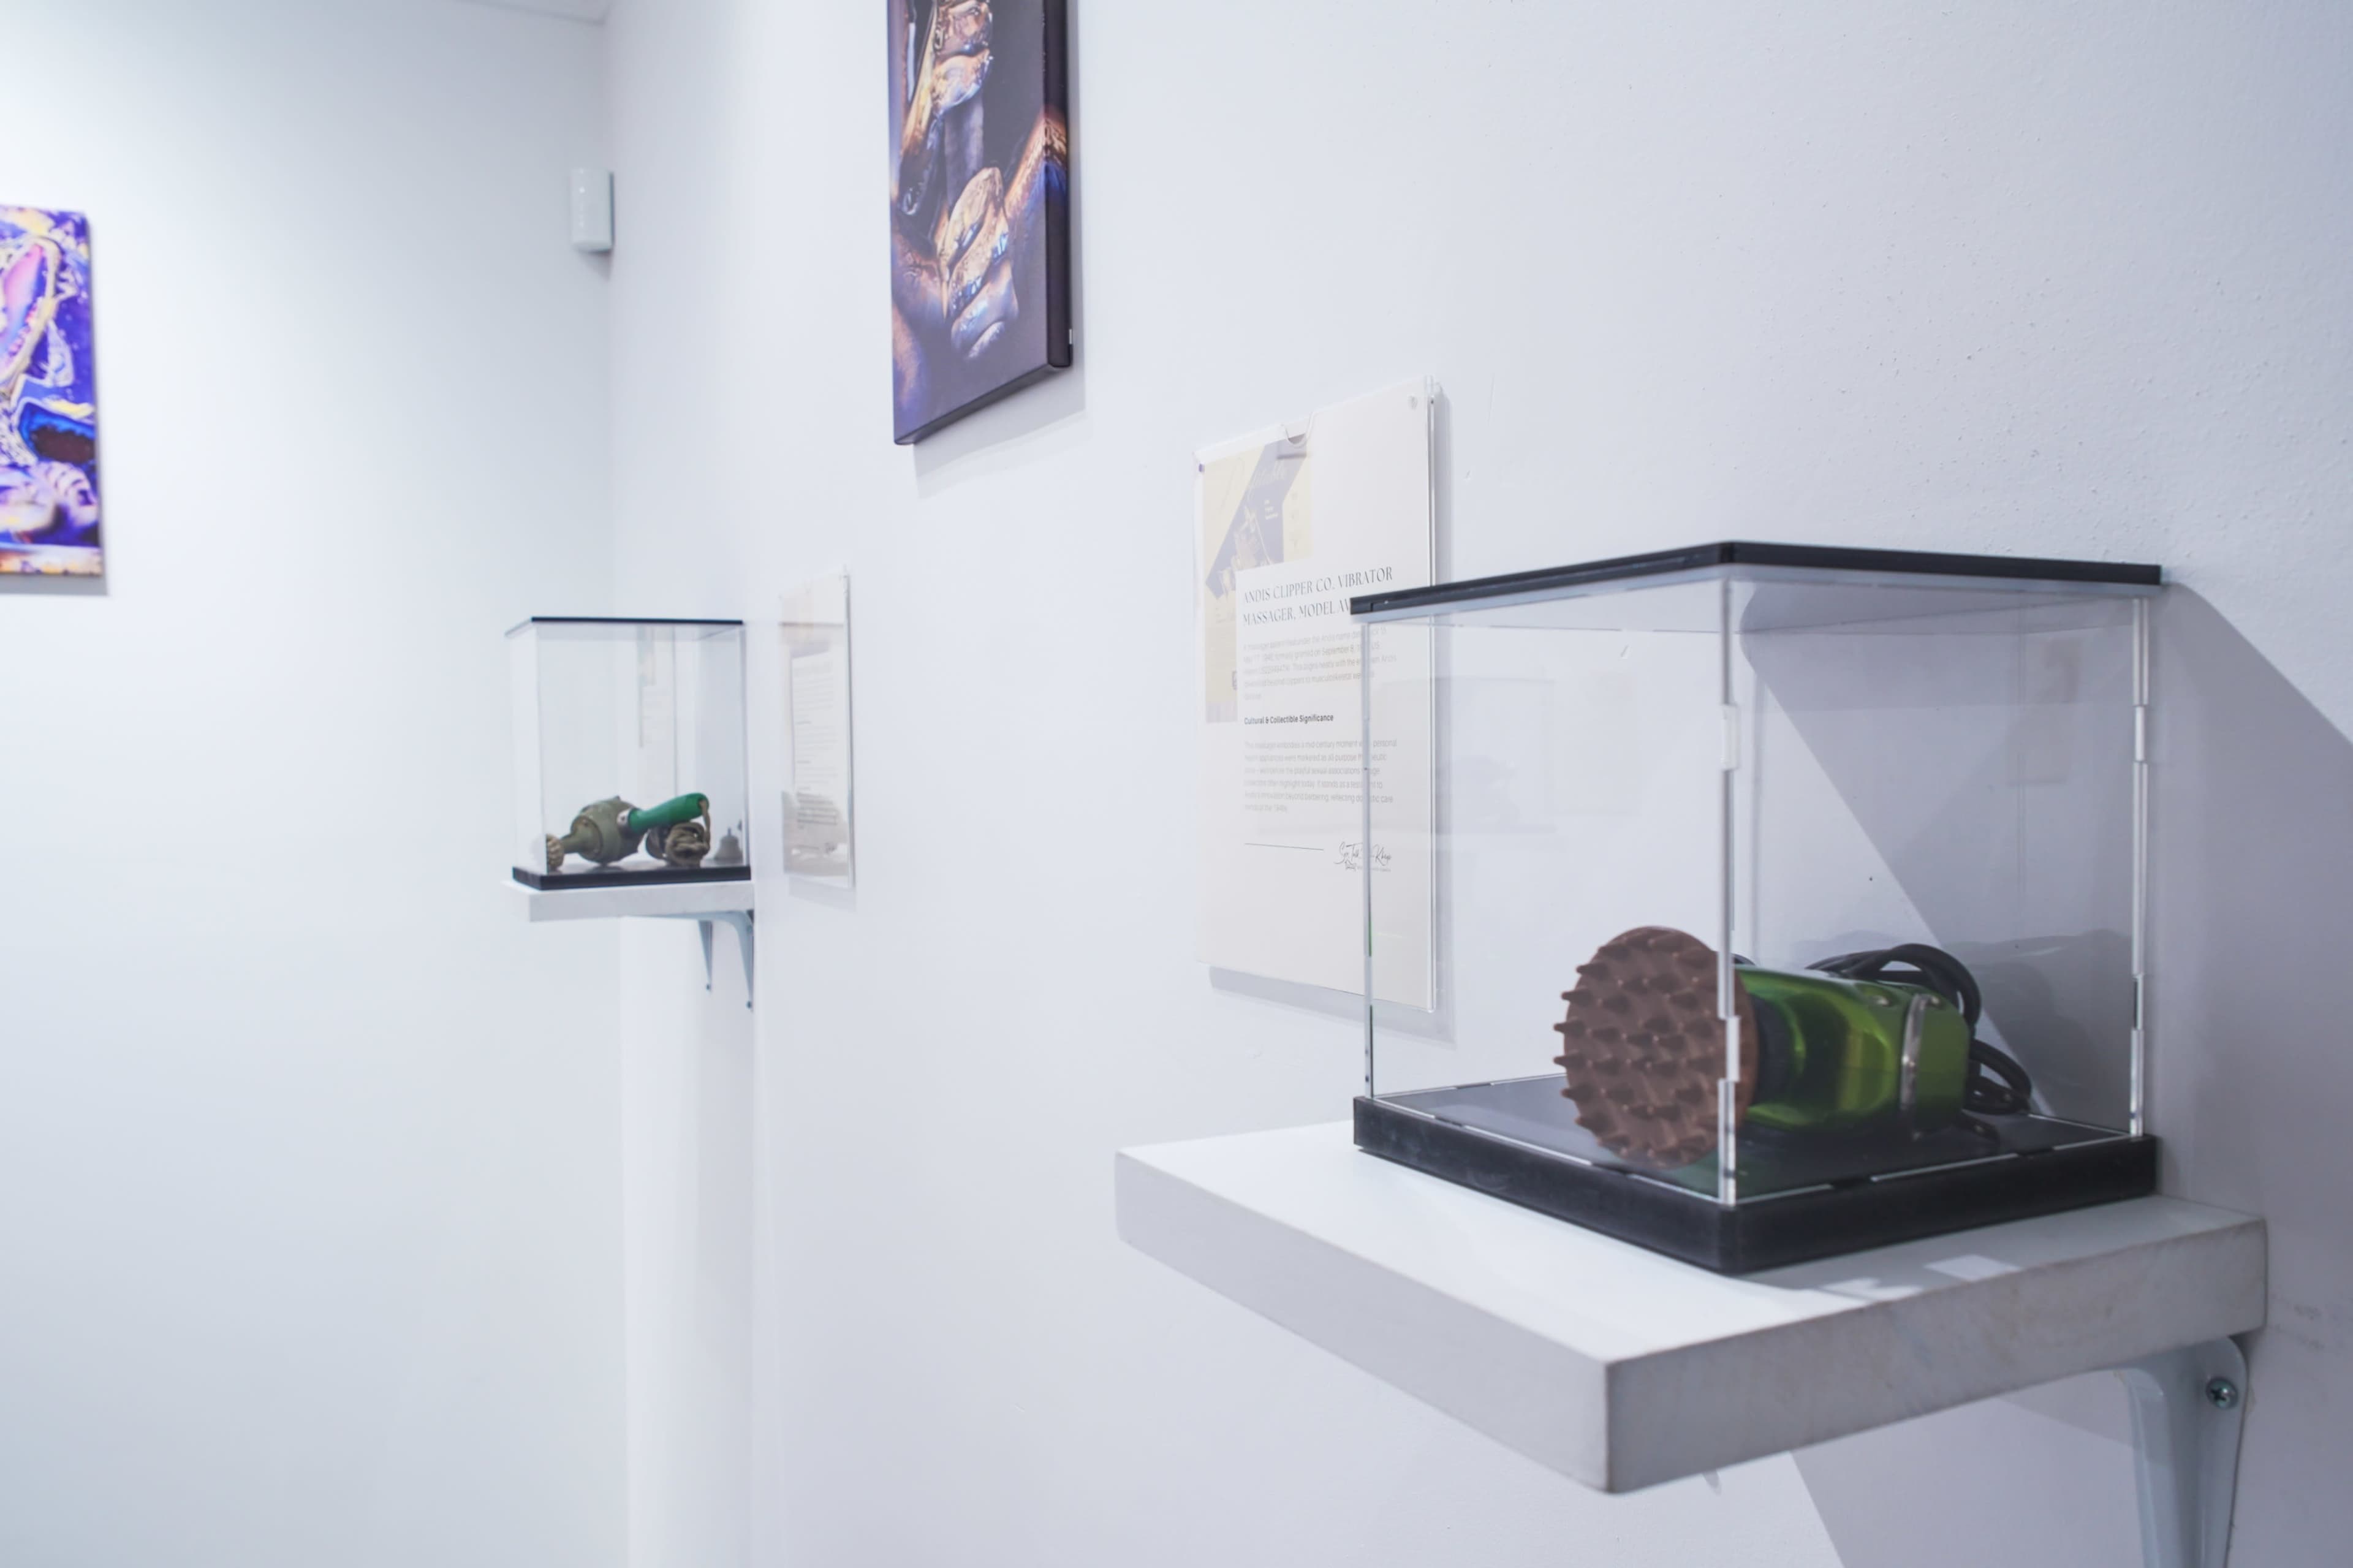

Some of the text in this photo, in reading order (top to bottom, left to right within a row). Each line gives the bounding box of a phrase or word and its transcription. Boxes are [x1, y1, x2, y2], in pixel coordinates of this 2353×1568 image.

[1243, 566, 1393, 604] ANDIS CLIPPER CO. VIBRATOR
[1243, 607, 1297, 626] MASSAGER,
[1298, 600, 1336, 619] MODEL
[1244, 717, 1265, 725] Cultural
[1270, 716, 1298, 724] Collectible
[1298, 714, 1334, 725] Significance
